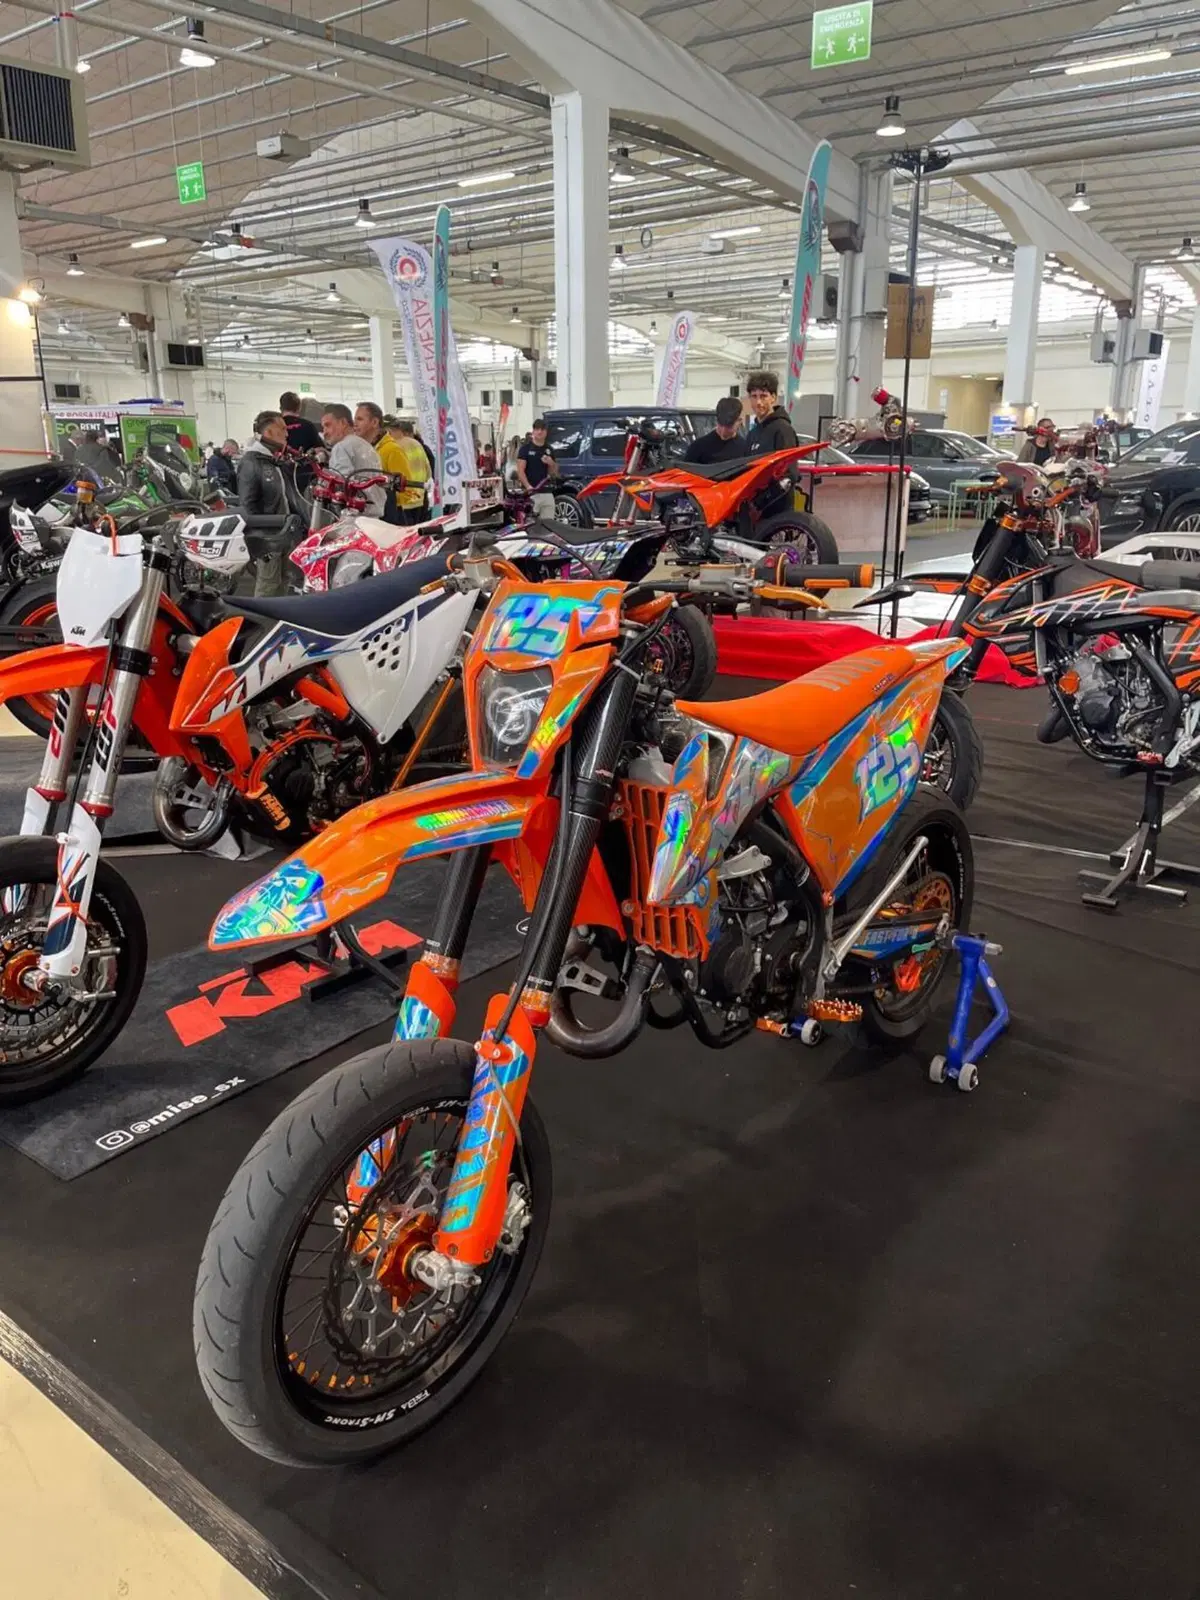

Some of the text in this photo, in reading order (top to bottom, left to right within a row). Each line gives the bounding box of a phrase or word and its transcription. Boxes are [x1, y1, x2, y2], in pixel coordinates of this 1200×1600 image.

[79, 422, 101, 431] RENT
[70, 625, 86, 637] KTM
[483, 594, 585, 661] 125
[853, 719, 921, 825] 125
[130, 1076, 245, 1134] @mise_sx
